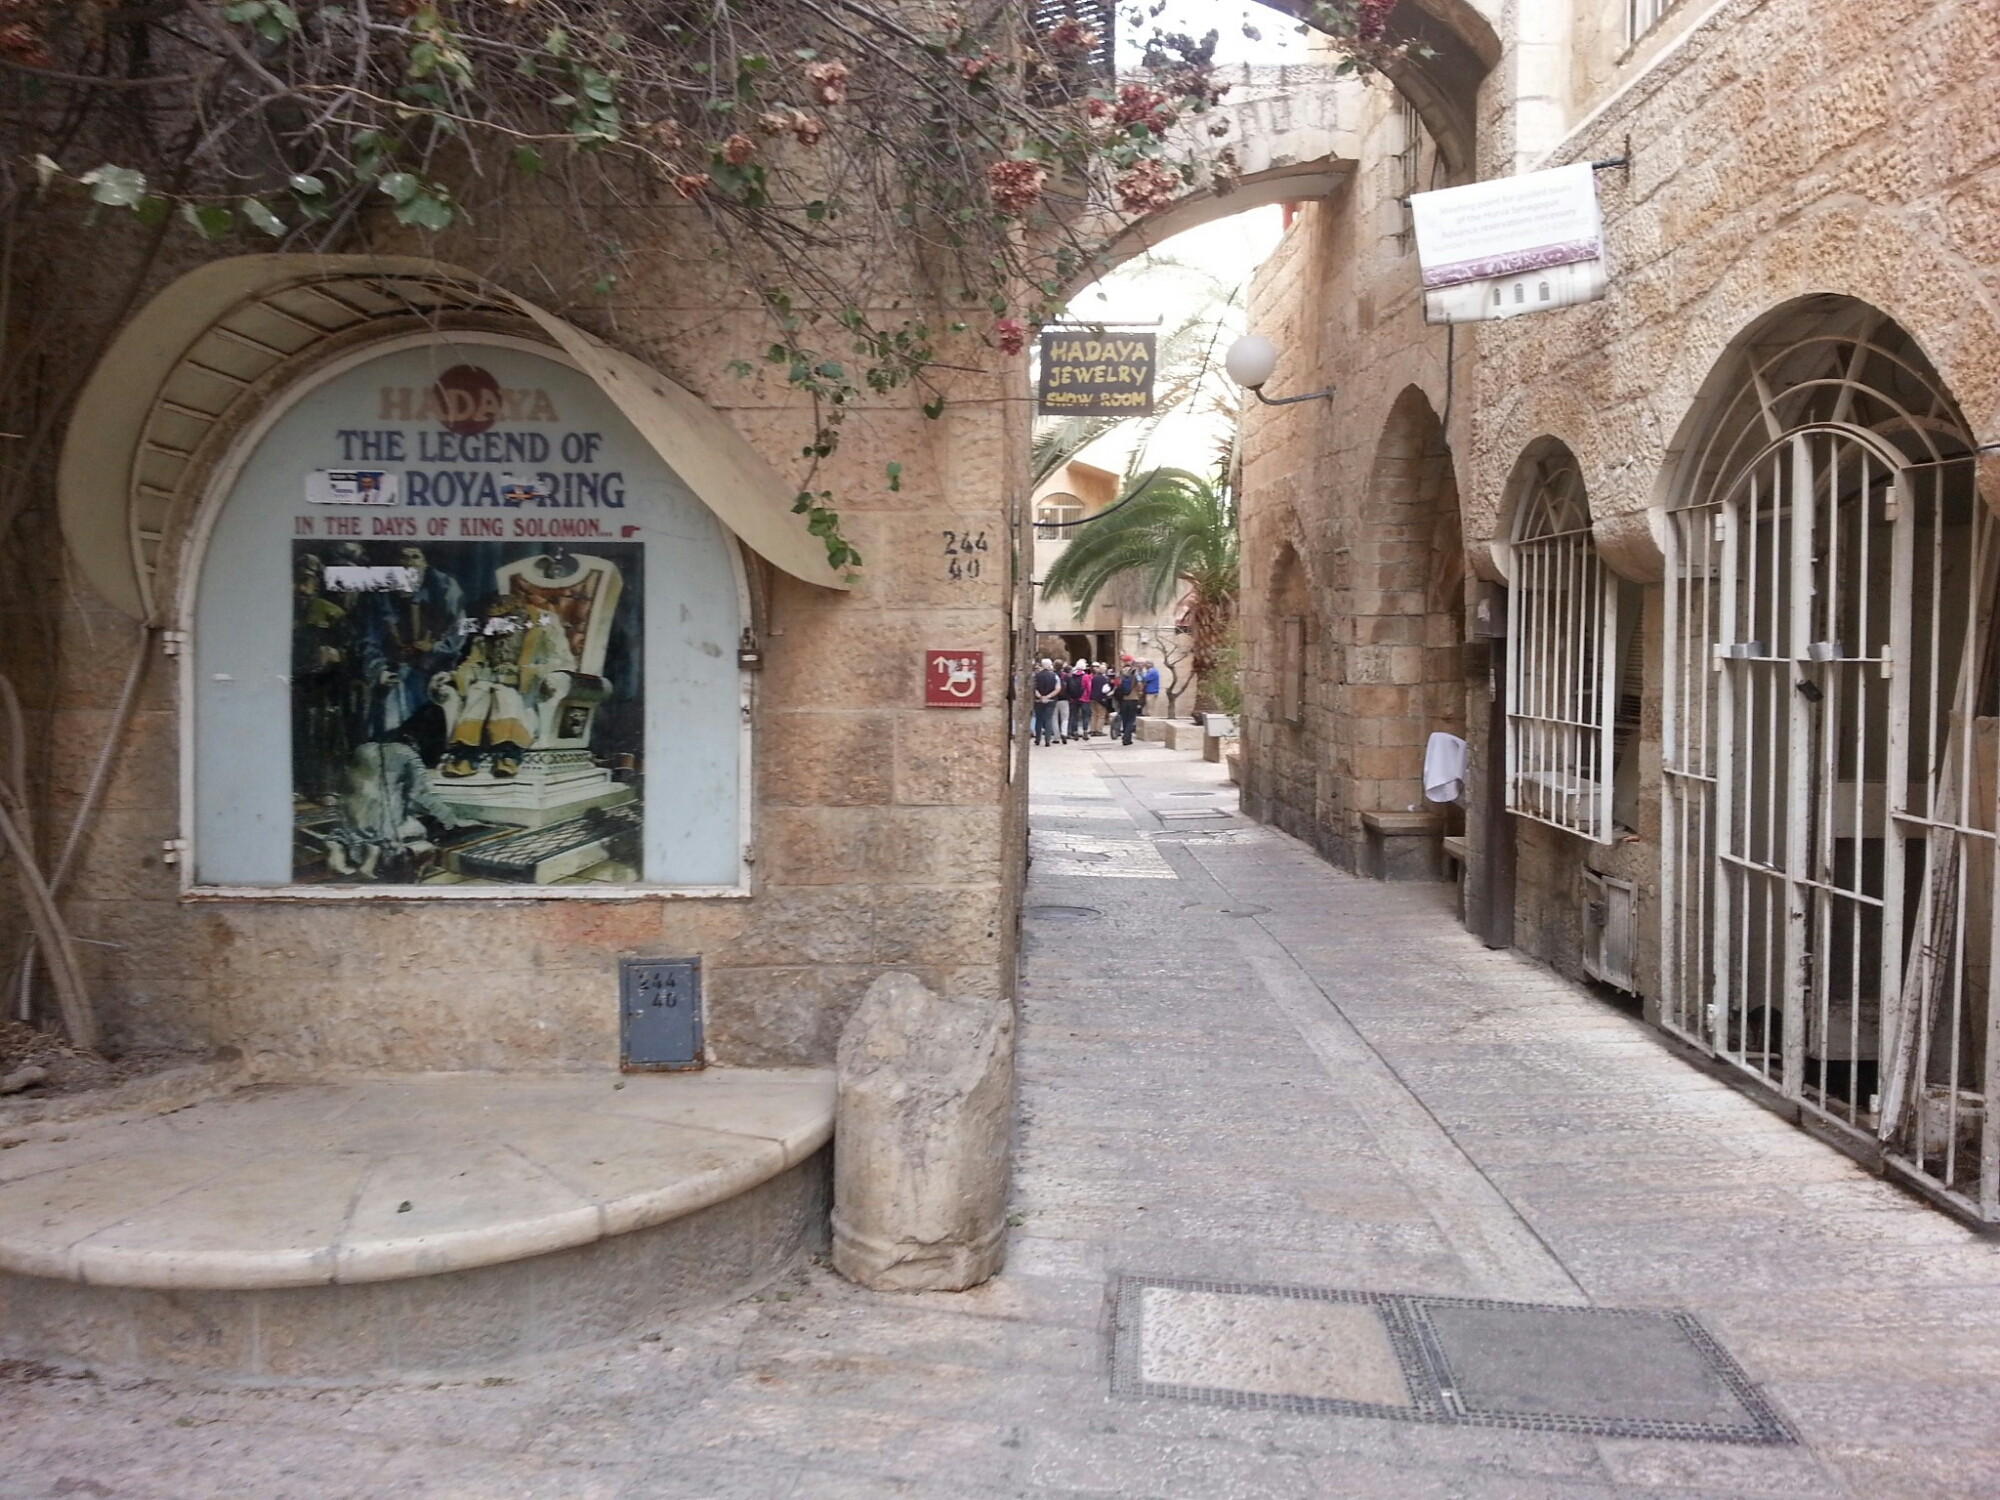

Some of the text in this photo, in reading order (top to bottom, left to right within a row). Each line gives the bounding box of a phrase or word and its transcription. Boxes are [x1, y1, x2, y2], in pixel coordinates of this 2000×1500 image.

[1050, 340, 1149, 361] HADAYA
[1049, 365, 1147, 387] JEWELRY
[378, 386, 560, 423] HADAYA
[1045, 391, 1146, 407] SHOW ROOM
[337, 430, 602, 463] THE LEGEND OF
[536, 472, 625, 508] RING
[295, 516, 314, 534] IN
[326, 517, 361, 535] THE
[373, 517, 417, 536] DAYS
[427, 517, 449, 536] OF
[460, 517, 504, 537] KING
